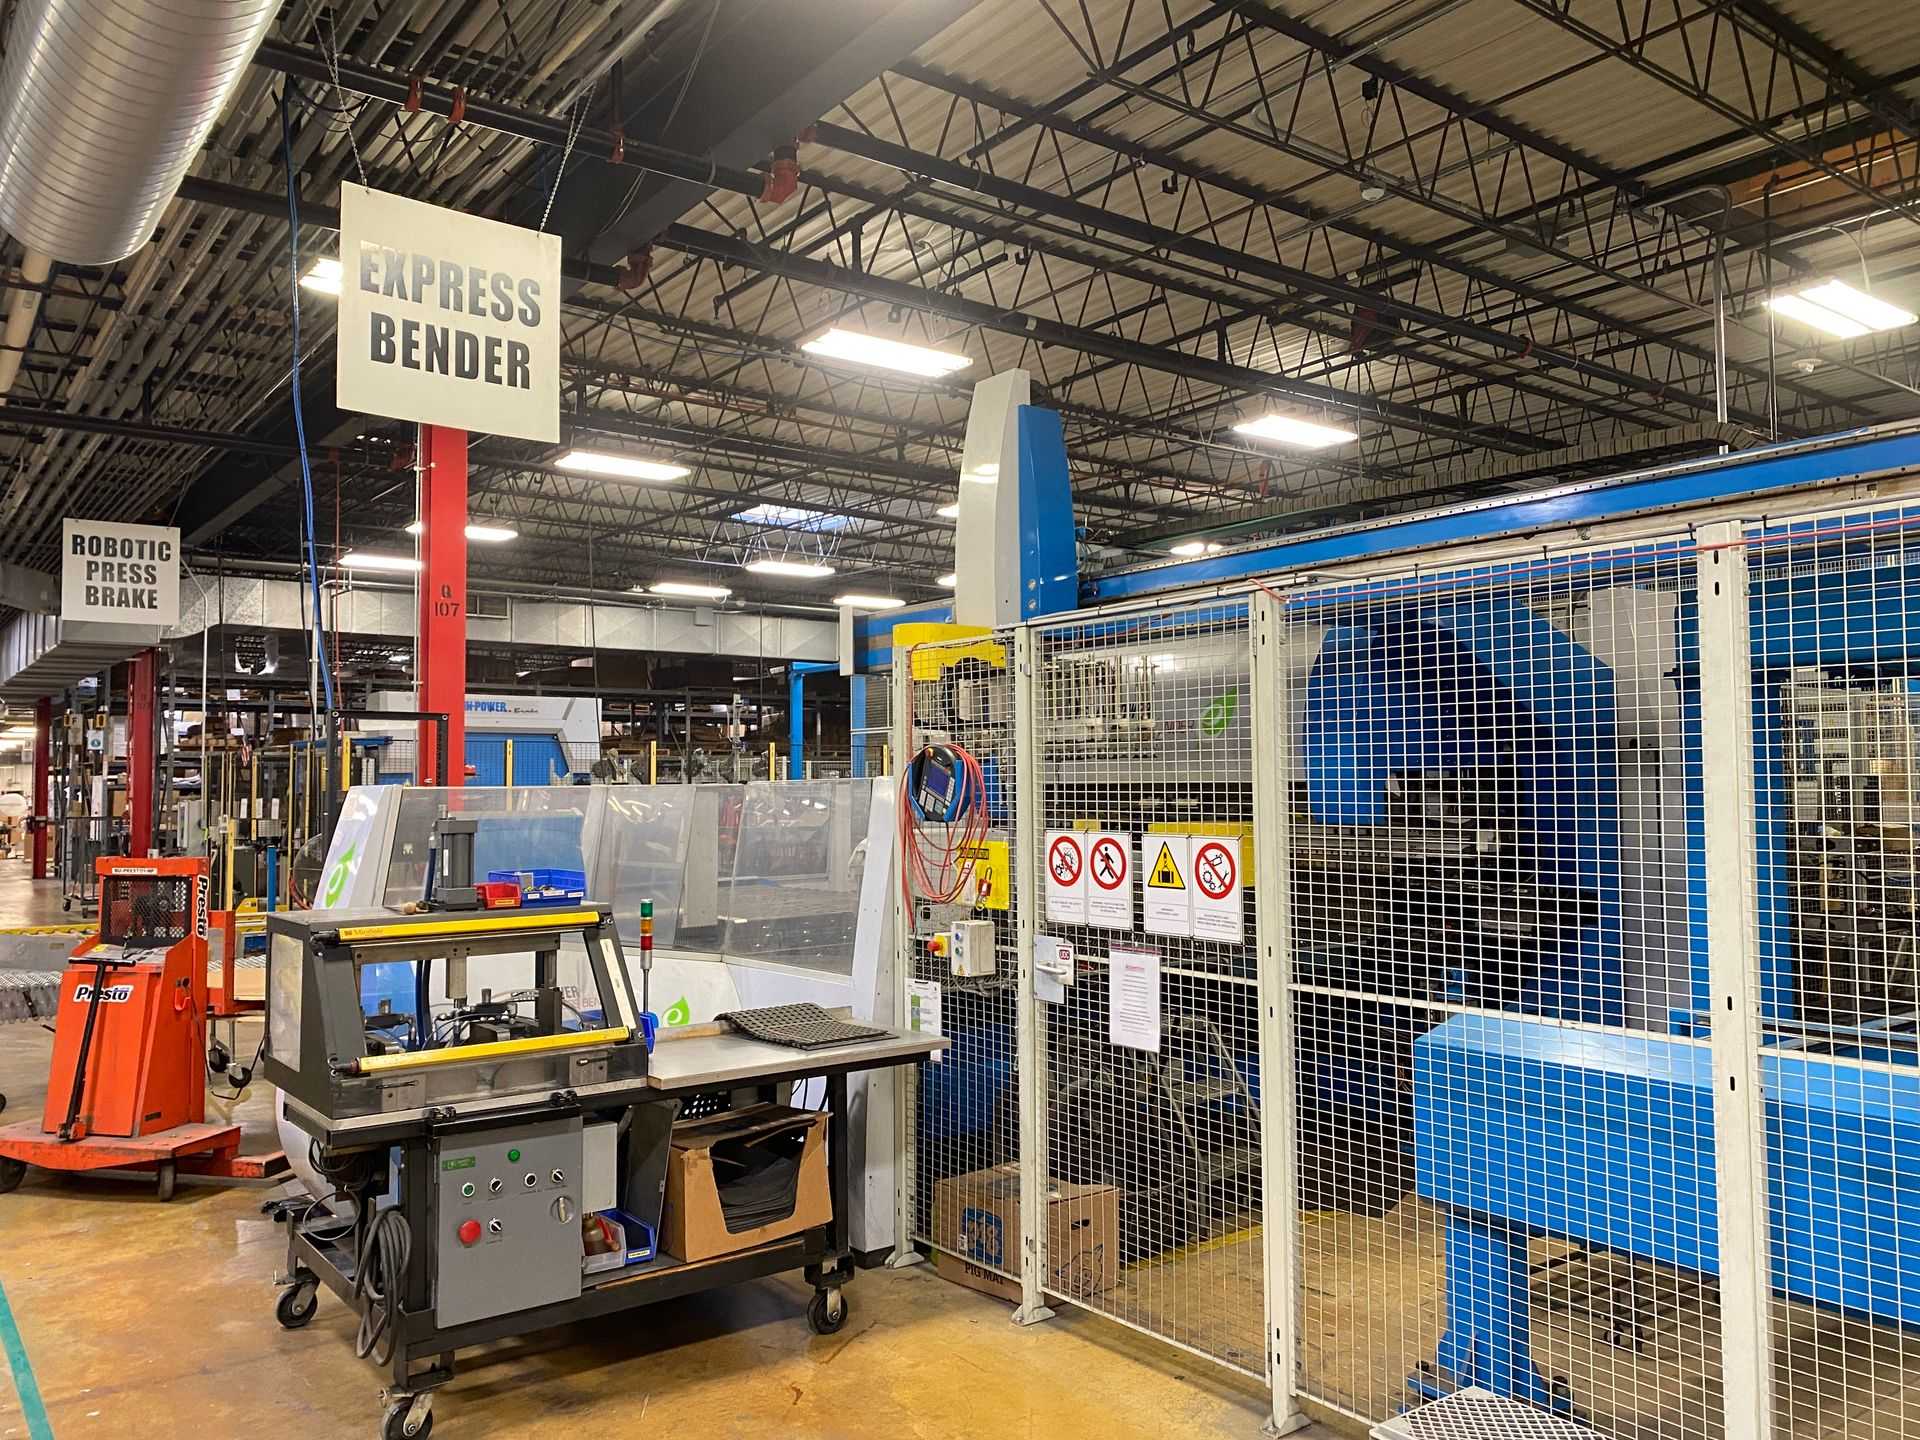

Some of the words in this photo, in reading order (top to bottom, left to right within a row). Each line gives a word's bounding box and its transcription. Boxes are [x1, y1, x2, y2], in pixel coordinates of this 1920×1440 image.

[359, 240, 541, 328] EXPRESS
[370, 311, 530, 389] BENDER
[71, 534, 171, 561] ROBOTIC
[86, 560, 157, 585] PRESS
[85, 585, 158, 609] BRAKE
[434, 601, 460, 617] 107
[196, 875, 209, 938] Presto
